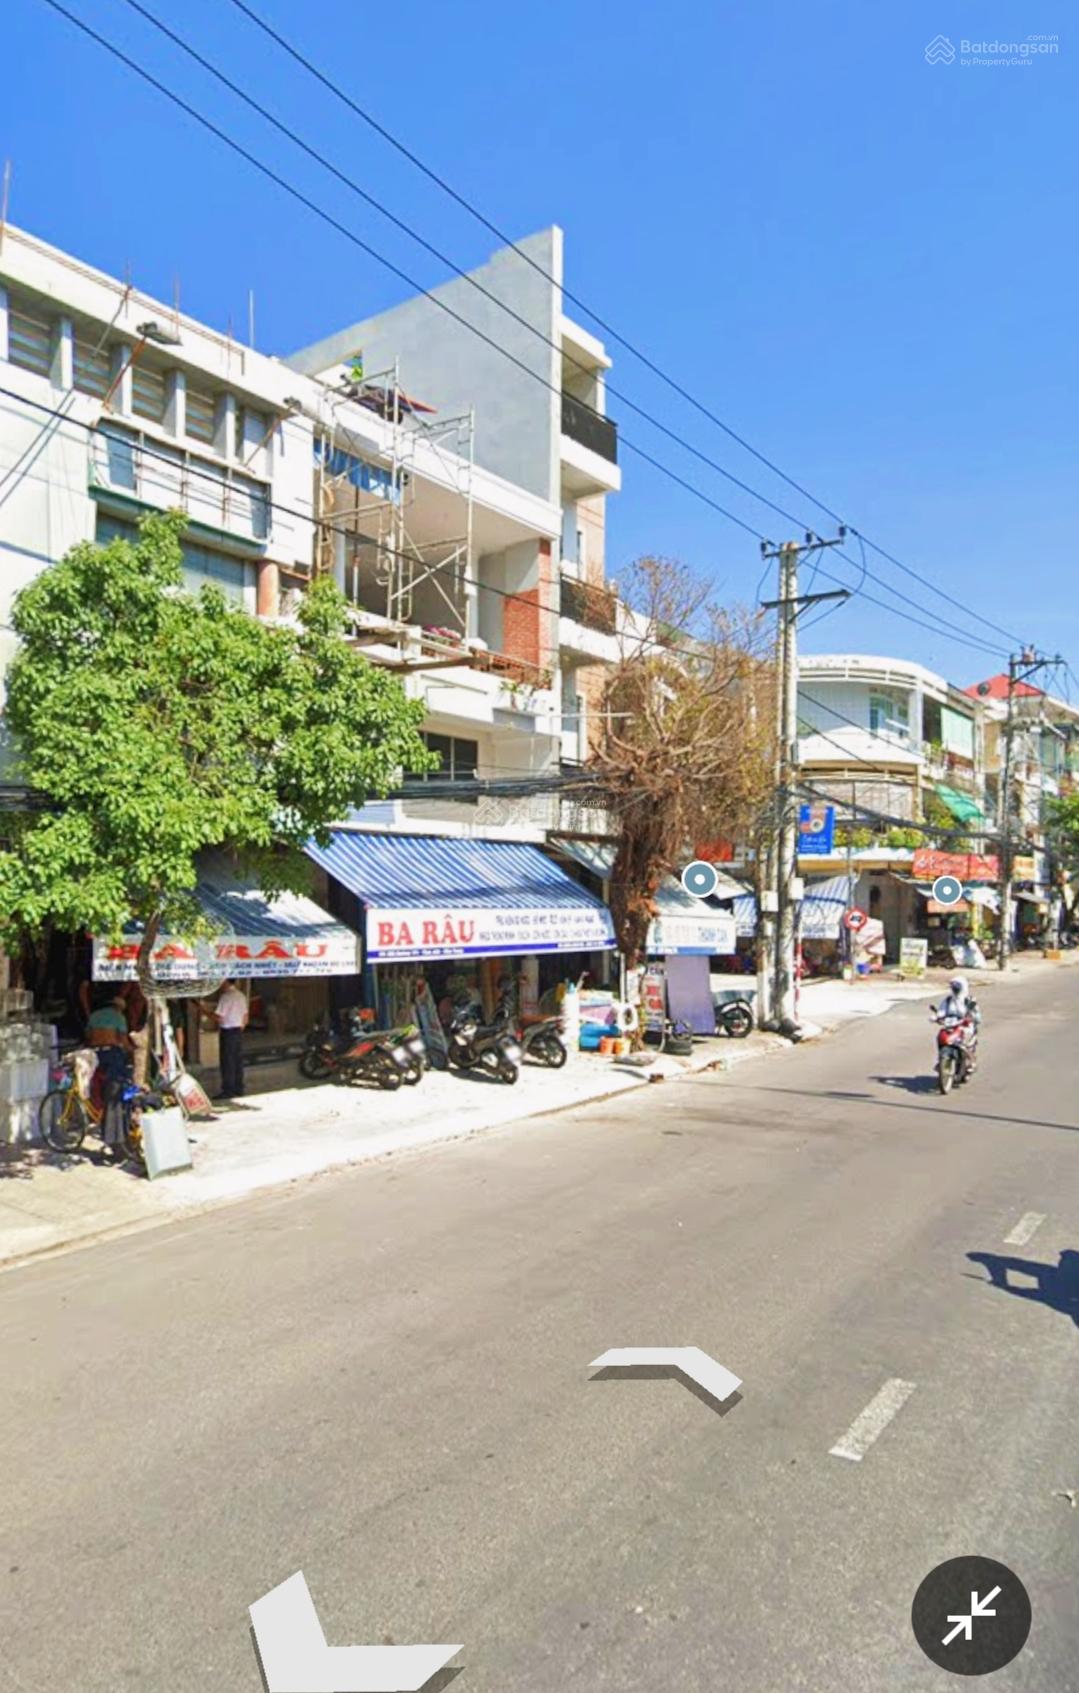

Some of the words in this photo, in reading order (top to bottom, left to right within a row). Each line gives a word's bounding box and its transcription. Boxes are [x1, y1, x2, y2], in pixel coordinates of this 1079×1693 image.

[377, 921, 414, 946] BA
[422, 914, 474, 944] RÂU
[215, 939, 328, 959] RÂU
